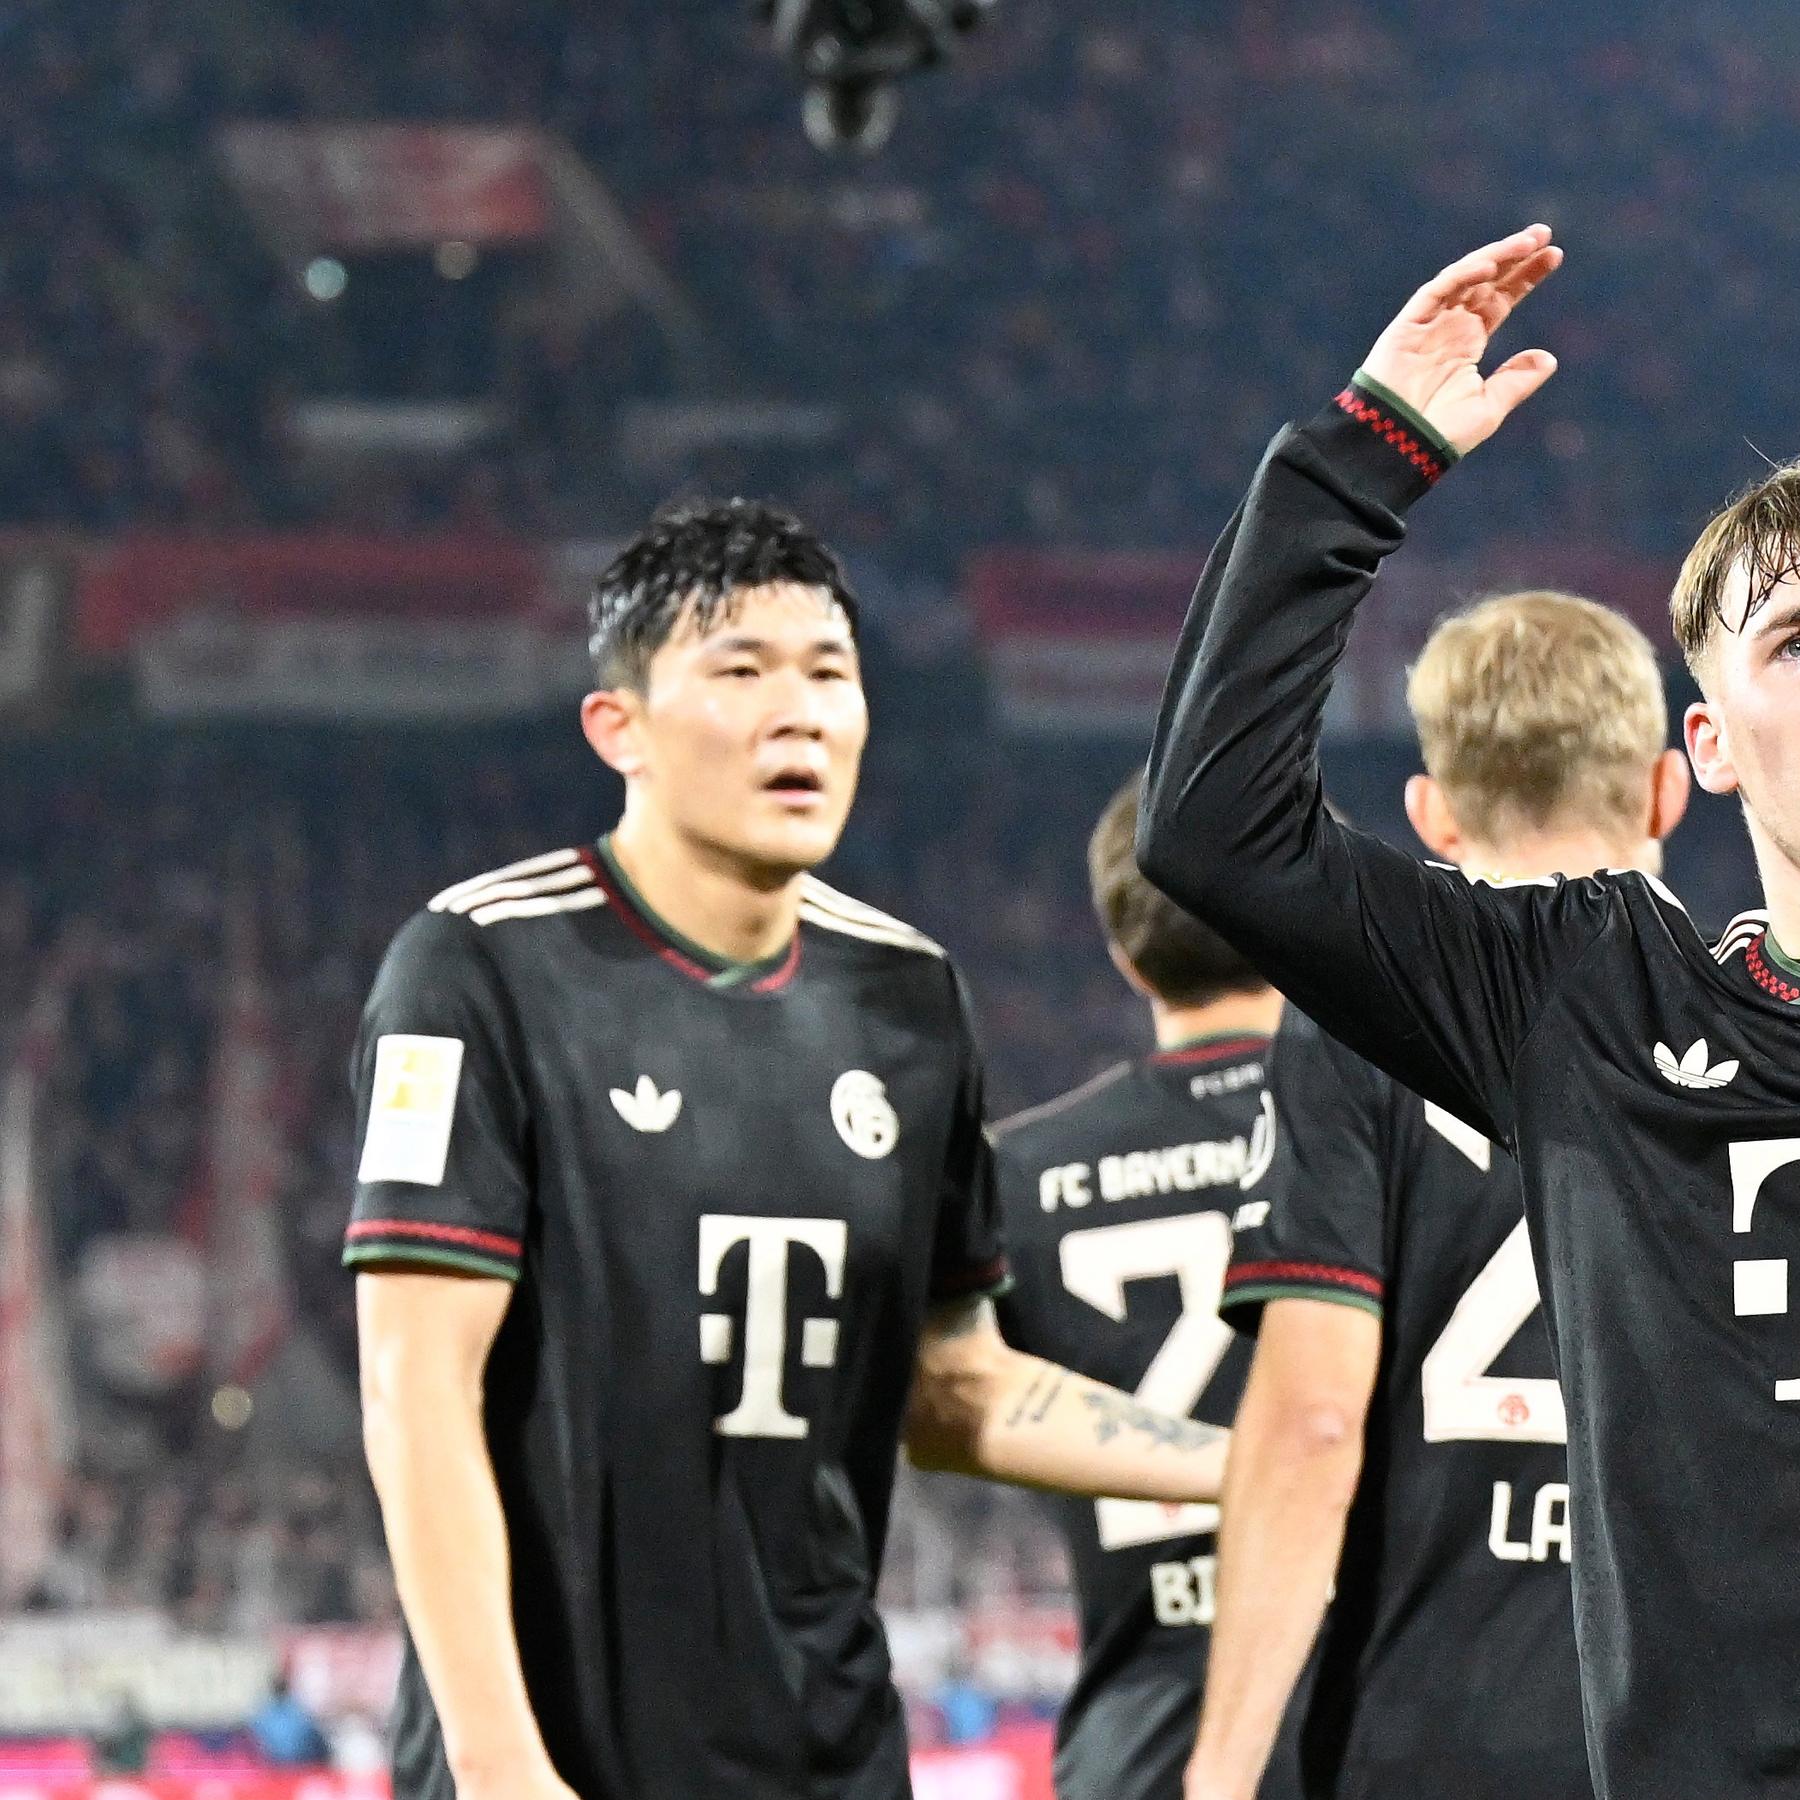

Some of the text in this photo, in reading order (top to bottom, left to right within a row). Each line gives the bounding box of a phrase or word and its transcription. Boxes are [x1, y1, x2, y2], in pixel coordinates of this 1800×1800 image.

[1039, 1161, 1092, 1213] FC
[699, 1213, 847, 1439] T
[1488, 1480, 1573, 1563] LA
[1151, 1554, 1217, 1627] BI
